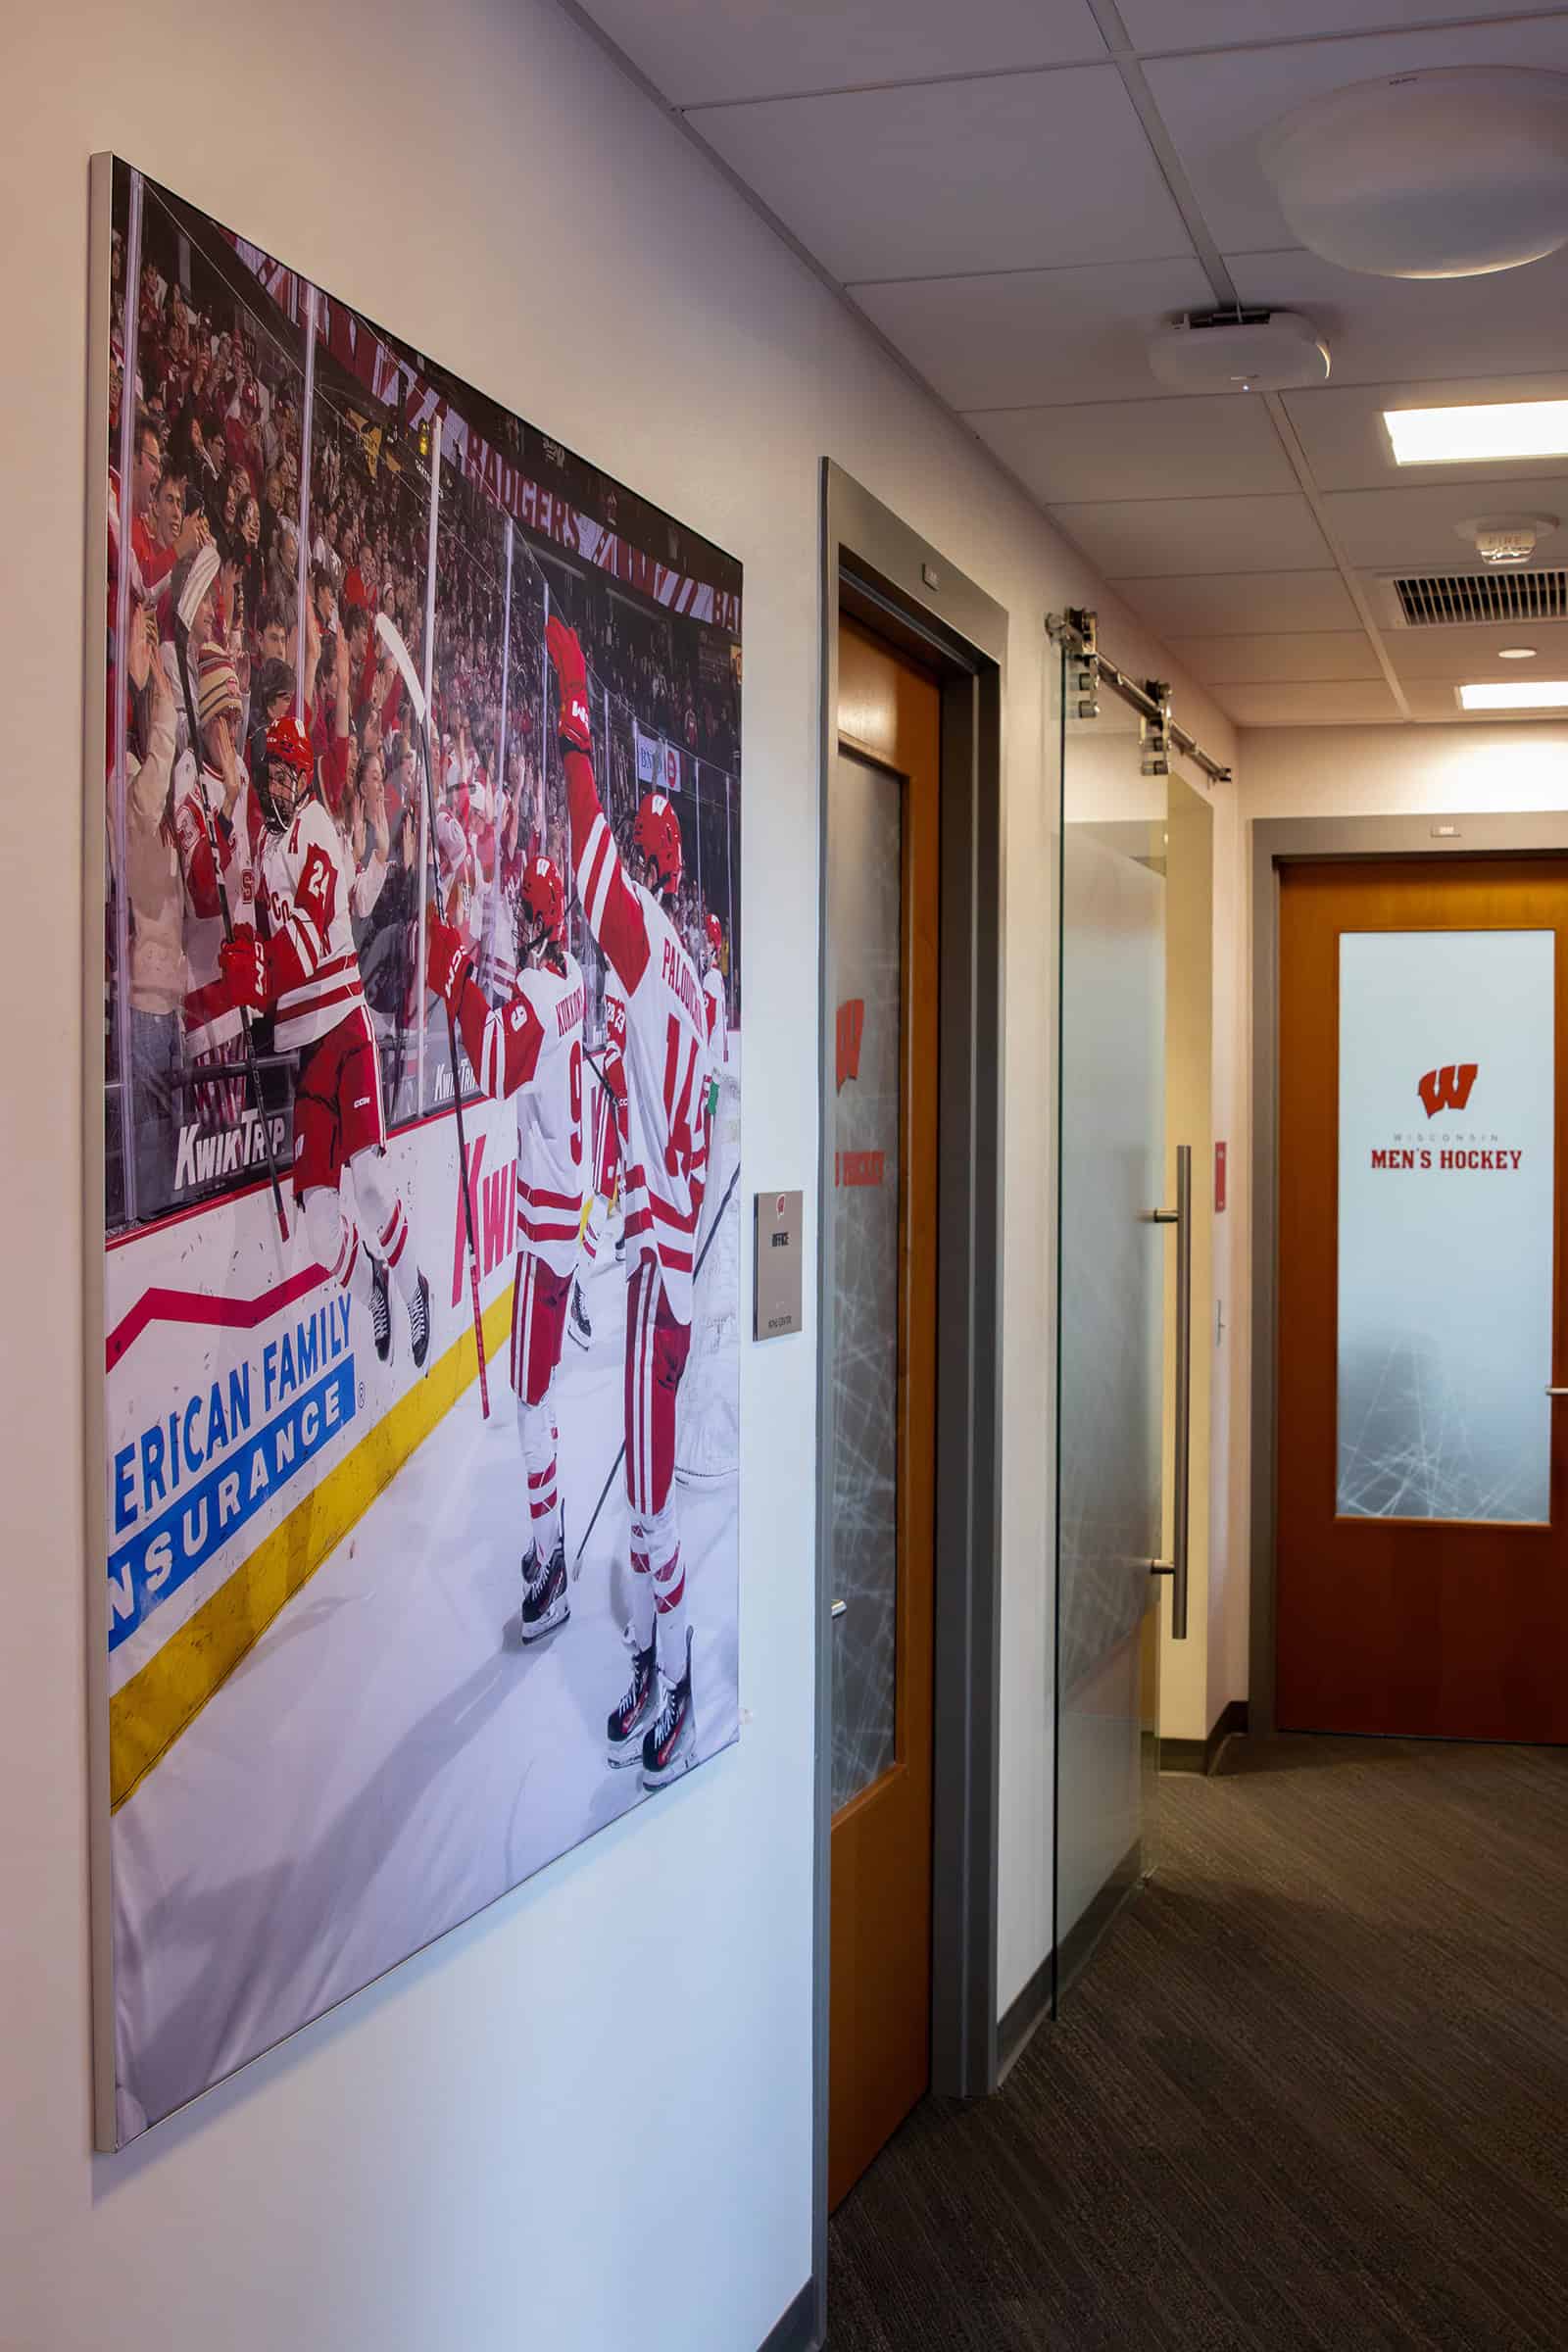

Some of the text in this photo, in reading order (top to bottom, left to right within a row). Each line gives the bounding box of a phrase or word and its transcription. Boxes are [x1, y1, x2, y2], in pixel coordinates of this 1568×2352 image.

[464, 432, 582, 552] BADGERS
[1371, 1149, 1522, 1169] MEN'S HOCKEY
[1394, 1133, 1498, 1142] WISCONSIN
[115, 1292, 352, 1536] ERICAN FAMILY
